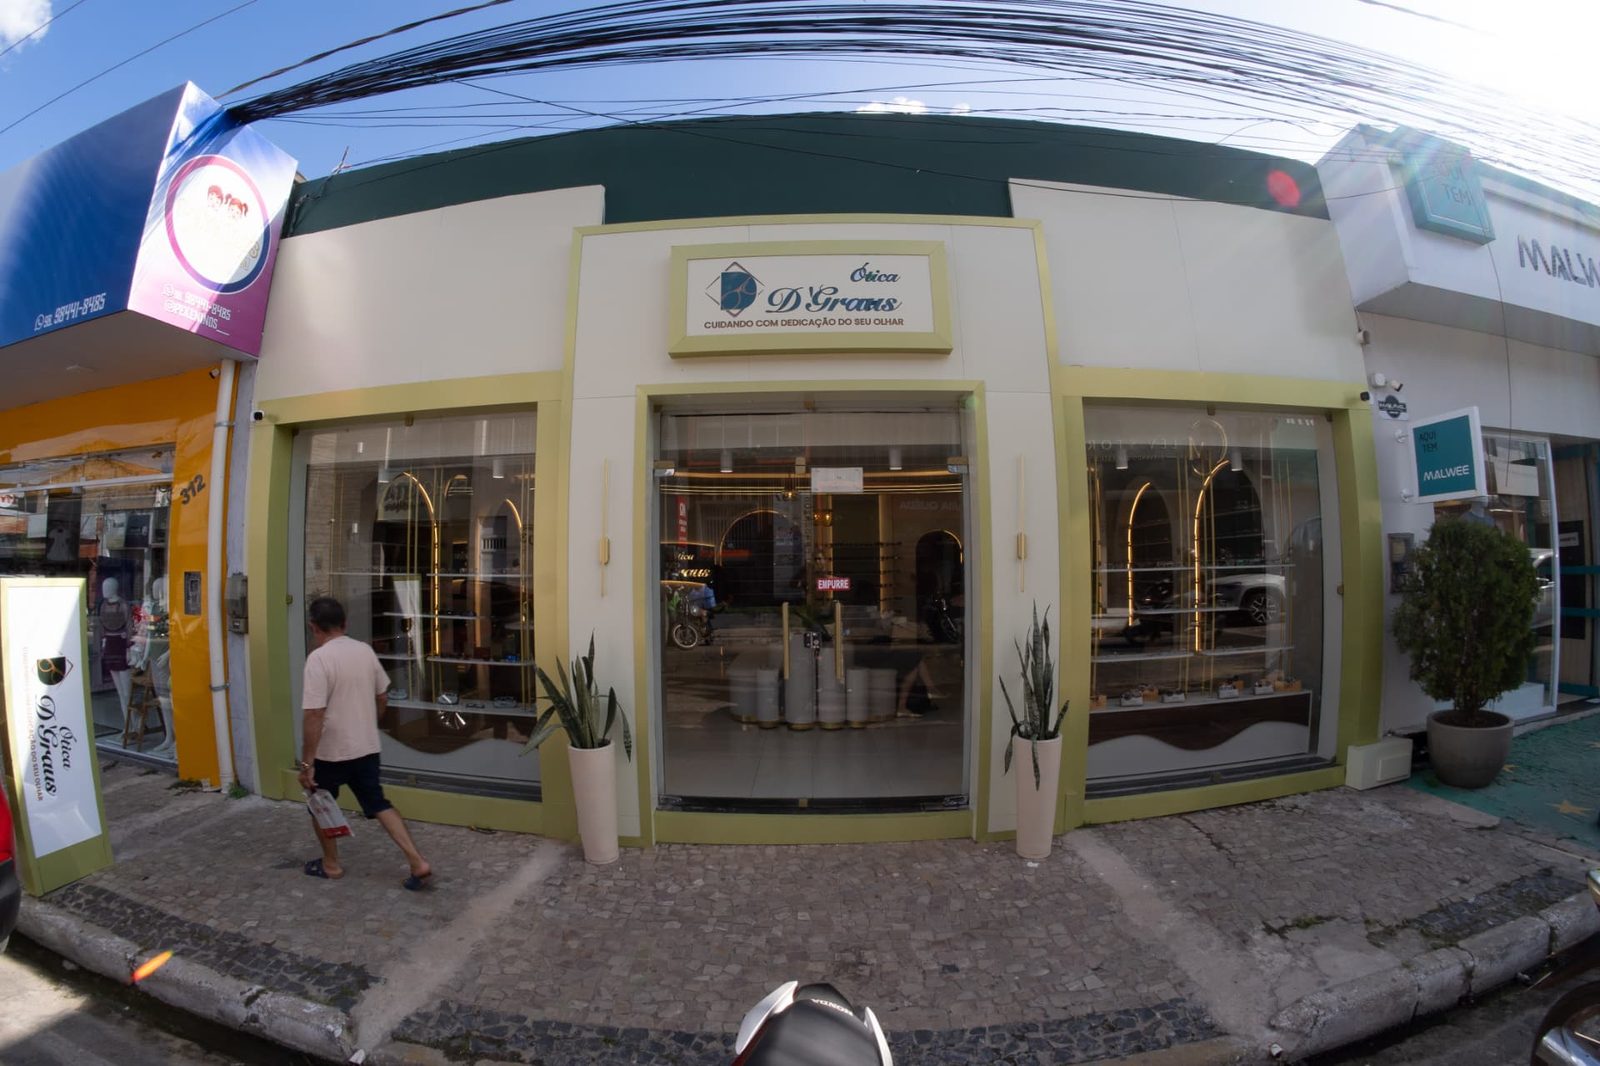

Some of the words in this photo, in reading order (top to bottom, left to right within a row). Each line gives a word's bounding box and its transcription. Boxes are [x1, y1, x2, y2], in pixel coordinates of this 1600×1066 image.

[850, 262, 901, 282] Ótica
[704, 320, 754, 329] CUIDANDO
[755, 319, 778, 327] COM
[781, 317, 836, 328] DEDICAÇÃO
[838, 318, 853, 326] DO
[854, 318, 872, 326] SEU
[873, 318, 904, 326] OLHAR
[1423, 464, 1470, 481] MALWEE
[180, 474, 206, 505] 312
[818, 579, 849, 590] EMPURRE
[60, 726, 77, 771] Ótica
[35, 777, 43, 800] OLHAR
